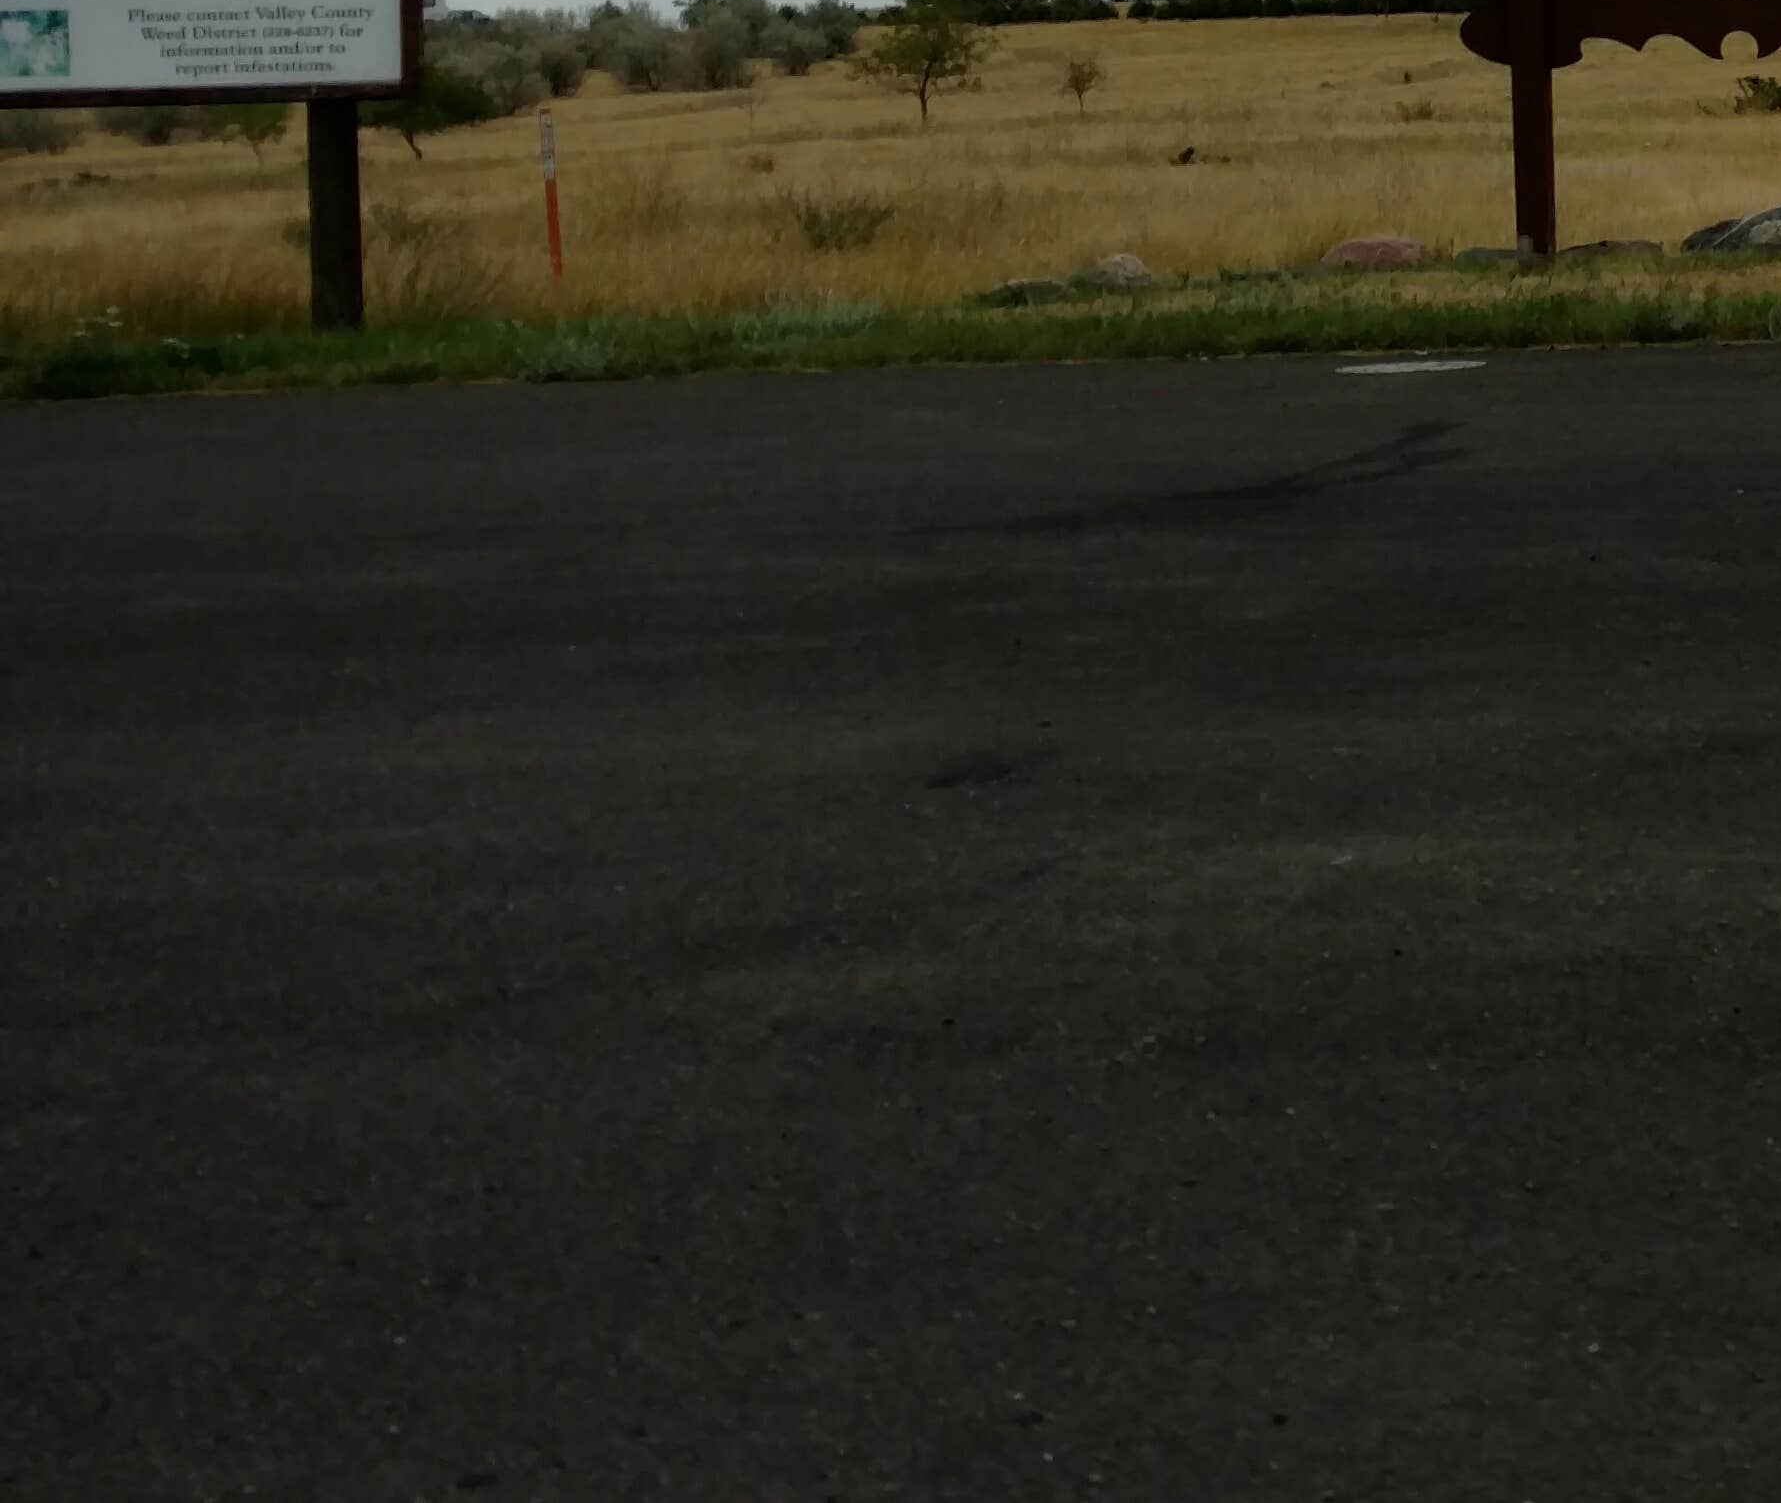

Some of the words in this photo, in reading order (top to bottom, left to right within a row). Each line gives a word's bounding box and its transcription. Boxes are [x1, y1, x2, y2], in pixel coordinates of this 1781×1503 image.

[128, 8, 181, 22] Please
[187, 9, 249, 21] contact
[256, 6, 306, 21] Valley
[311, 5, 374, 20] County
[141, 27, 186, 41] Weed
[193, 26, 257, 40] District
[339, 24, 364, 38] for
[160, 42, 263, 58] information
[328, 42, 346, 54] to
[175, 60, 228, 78] report
